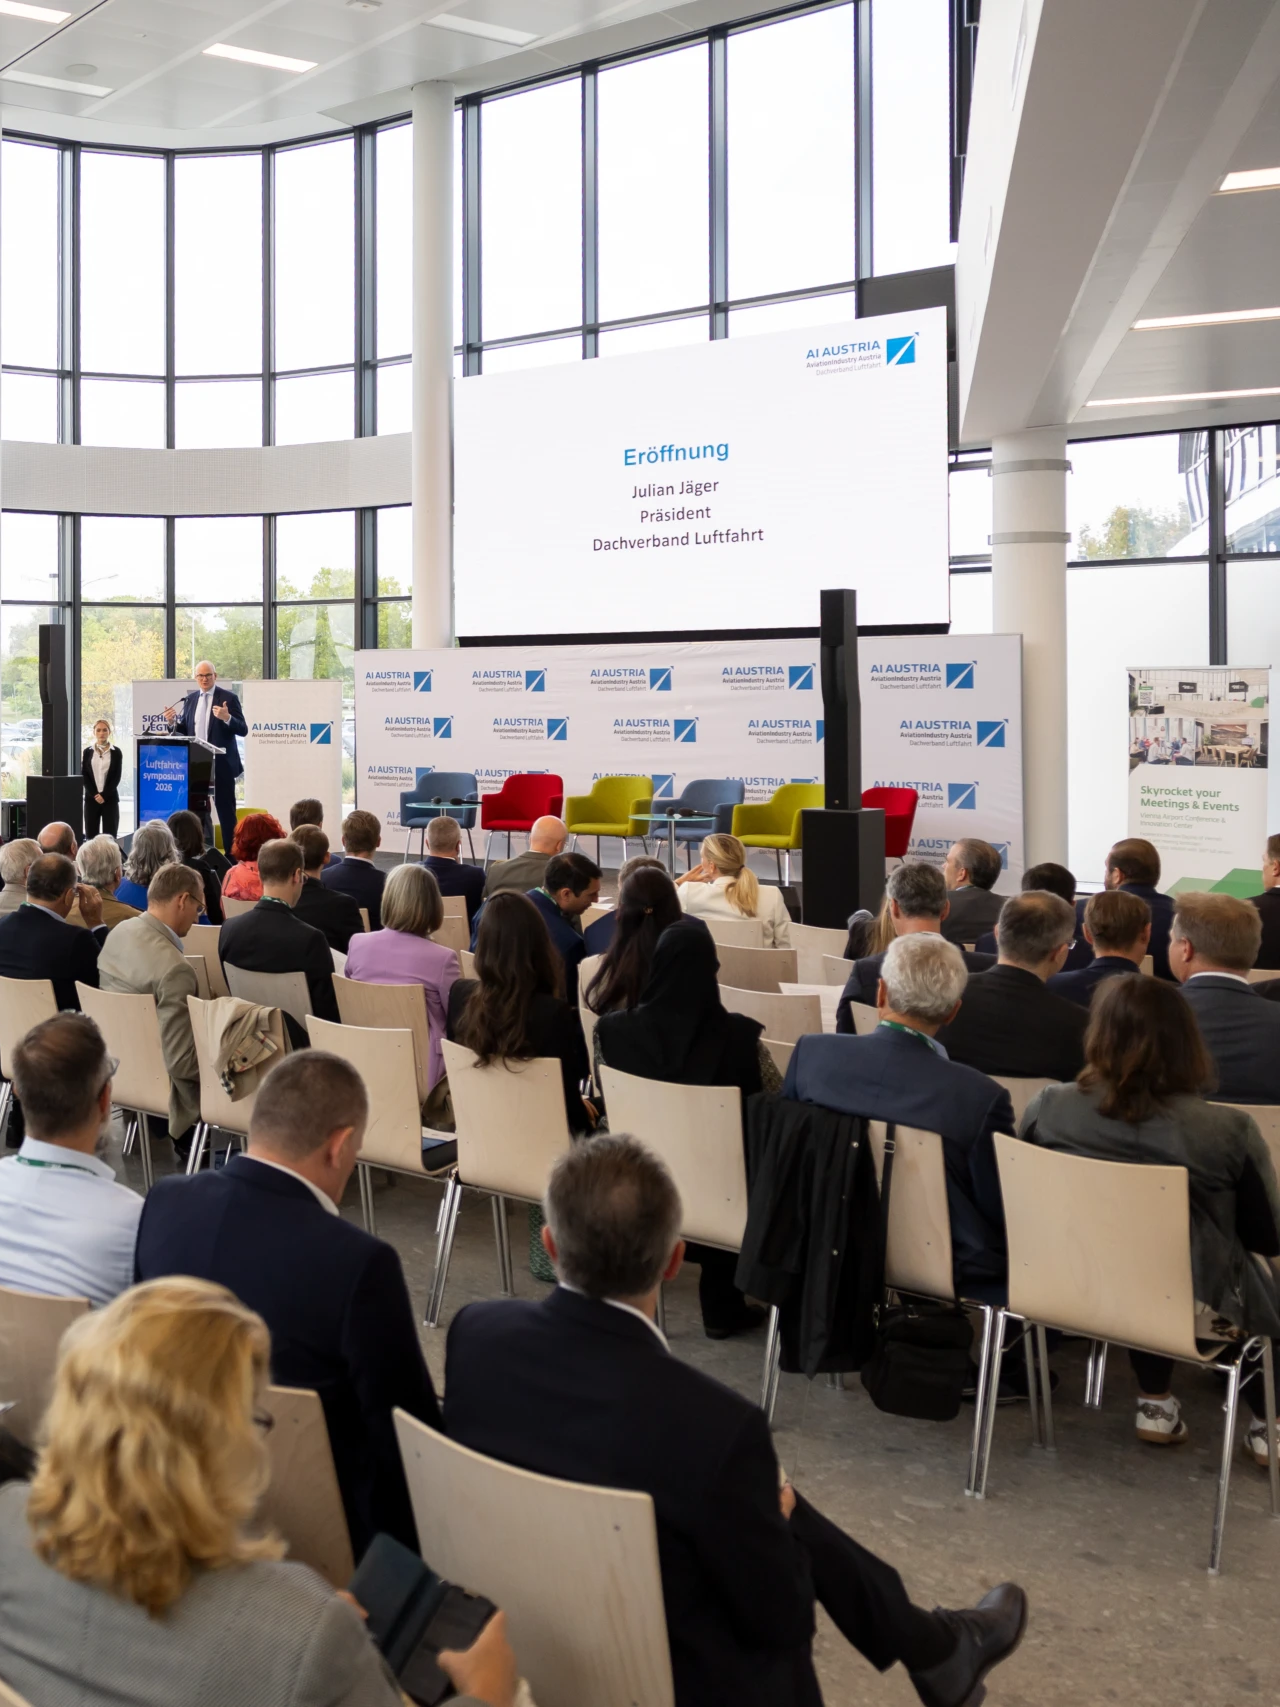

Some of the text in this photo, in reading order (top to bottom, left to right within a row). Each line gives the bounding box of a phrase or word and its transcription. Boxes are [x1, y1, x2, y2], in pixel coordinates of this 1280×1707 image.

[806, 340, 881, 359] AI AUSTRIA
[858, 354, 882, 362] Austria
[624, 442, 729, 466] Eröffnung
[632, 480, 719, 498] Julian Jäger
[640, 506, 712, 523] Präsident
[593, 528, 764, 551] Dachverband Luftfahrt
[590, 668, 646, 677] AI AUSTRIA
[722, 666, 784, 676] AI AUSTRIA
[870, 664, 941, 673] AI AUSTRIA
[472, 670, 522, 679] AI AUSTRIA
[394, 717, 430, 725] AUSTRIA
[493, 718, 544, 726] AI AUSTRIA
[613, 719, 670, 727] AI AUSTRIA
[748, 720, 812, 728] AI AUSTRIA
[900, 720, 972, 730] AI AUSTRIA
[145, 760, 182, 770] Luftfahrt-
[377, 766, 412, 774] AUSTRIA
[143, 772, 184, 781] symposium
[155, 782, 173, 791] 2026
[1140, 786, 1221, 799] Skyrocket your
[1140, 798, 1240, 812] Meetings & Events
[1185, 815, 1219, 823] Conference
